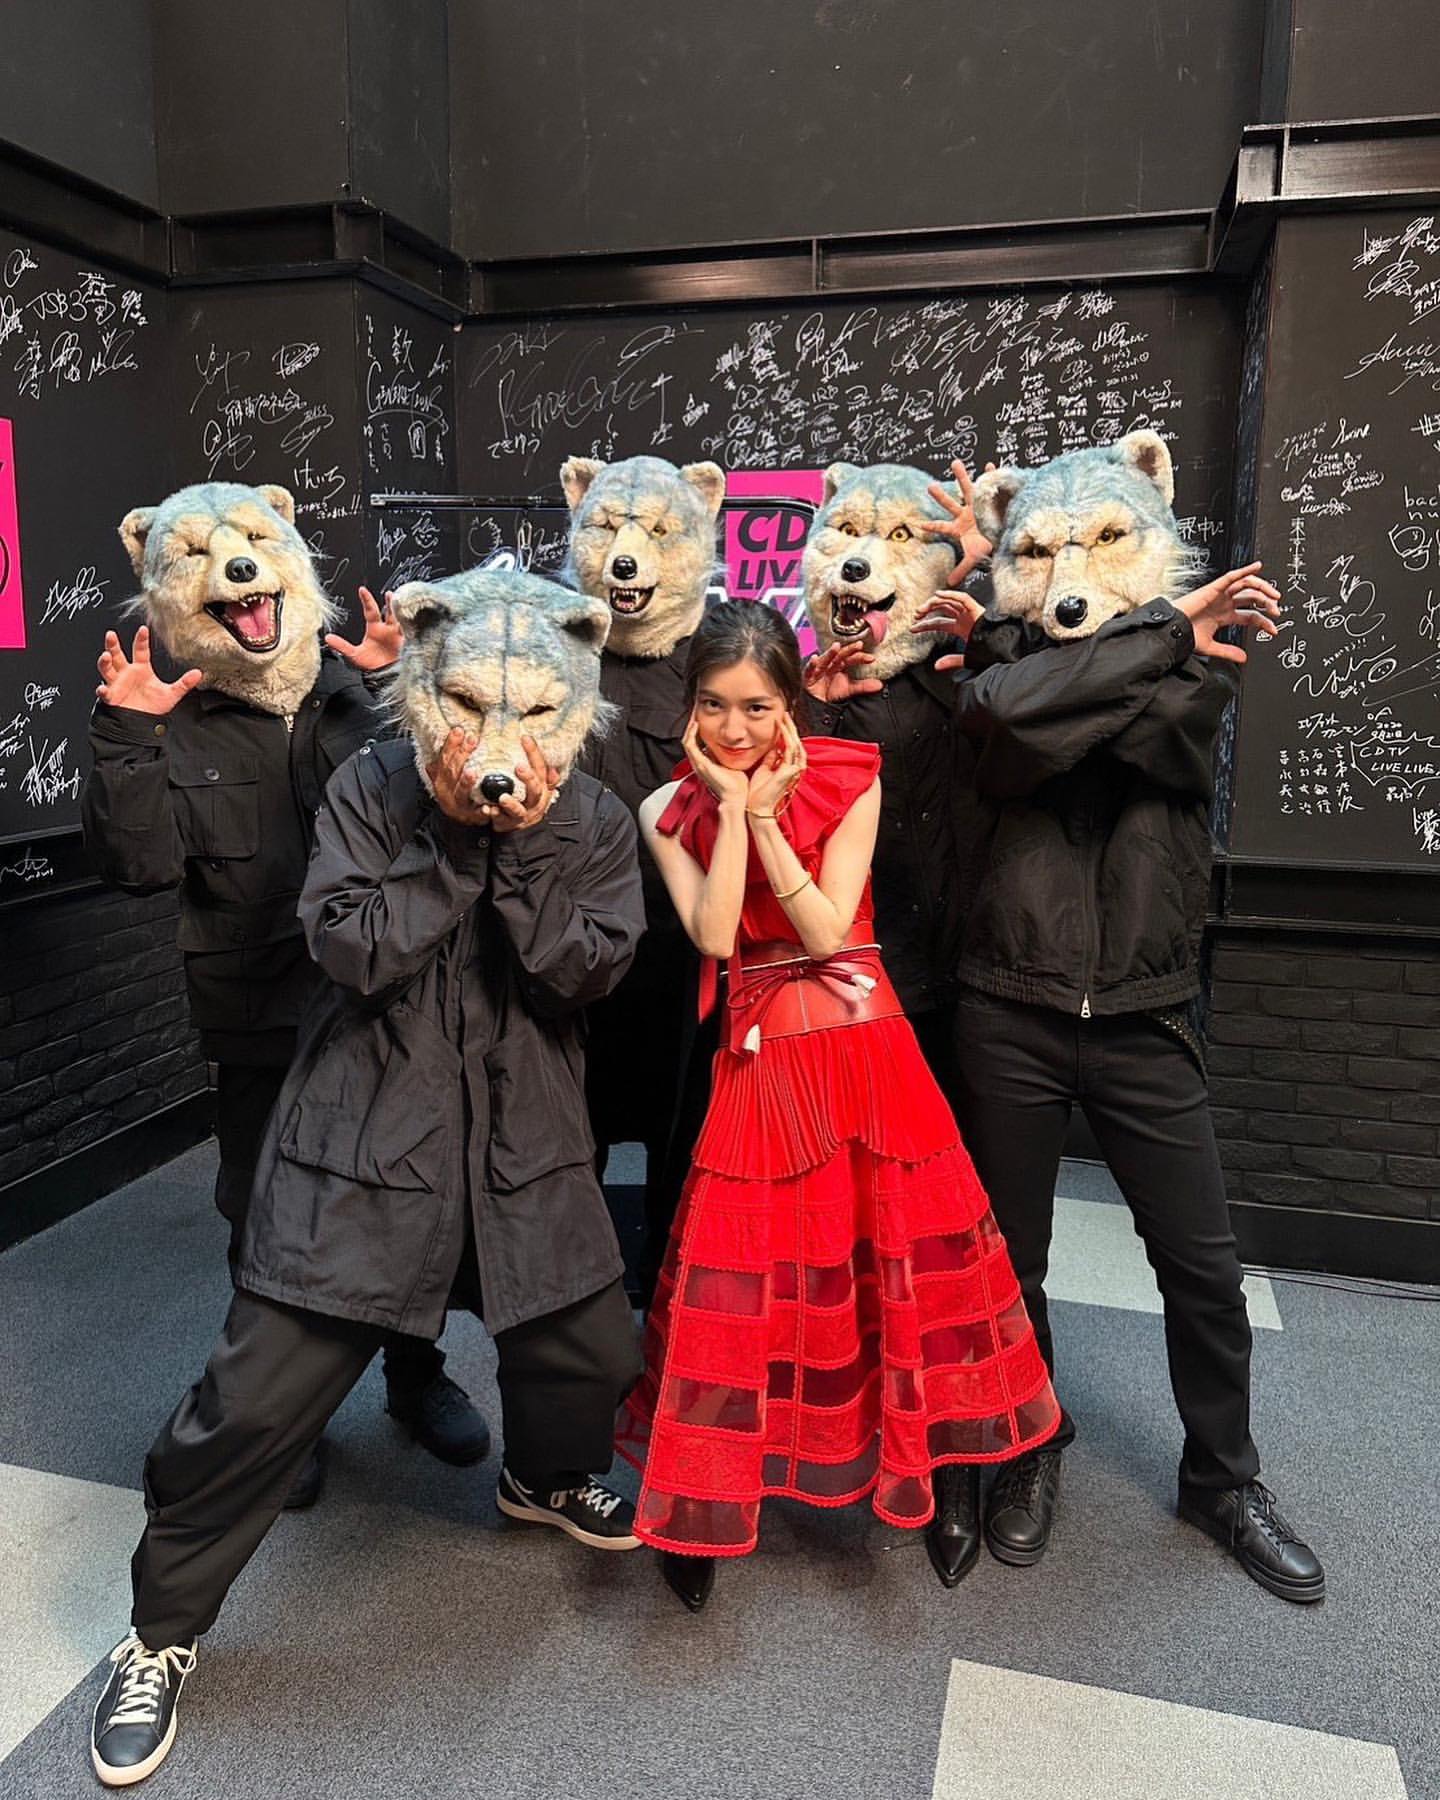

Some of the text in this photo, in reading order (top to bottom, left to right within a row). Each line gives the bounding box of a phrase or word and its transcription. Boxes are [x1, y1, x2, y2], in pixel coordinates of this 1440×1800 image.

[1404, 485, 1440, 508] bac
[1288, 517, 1306, 593] 東京事変
[737, 559, 803, 590] LIV
[1371, 762, 1402, 773] LIVE
